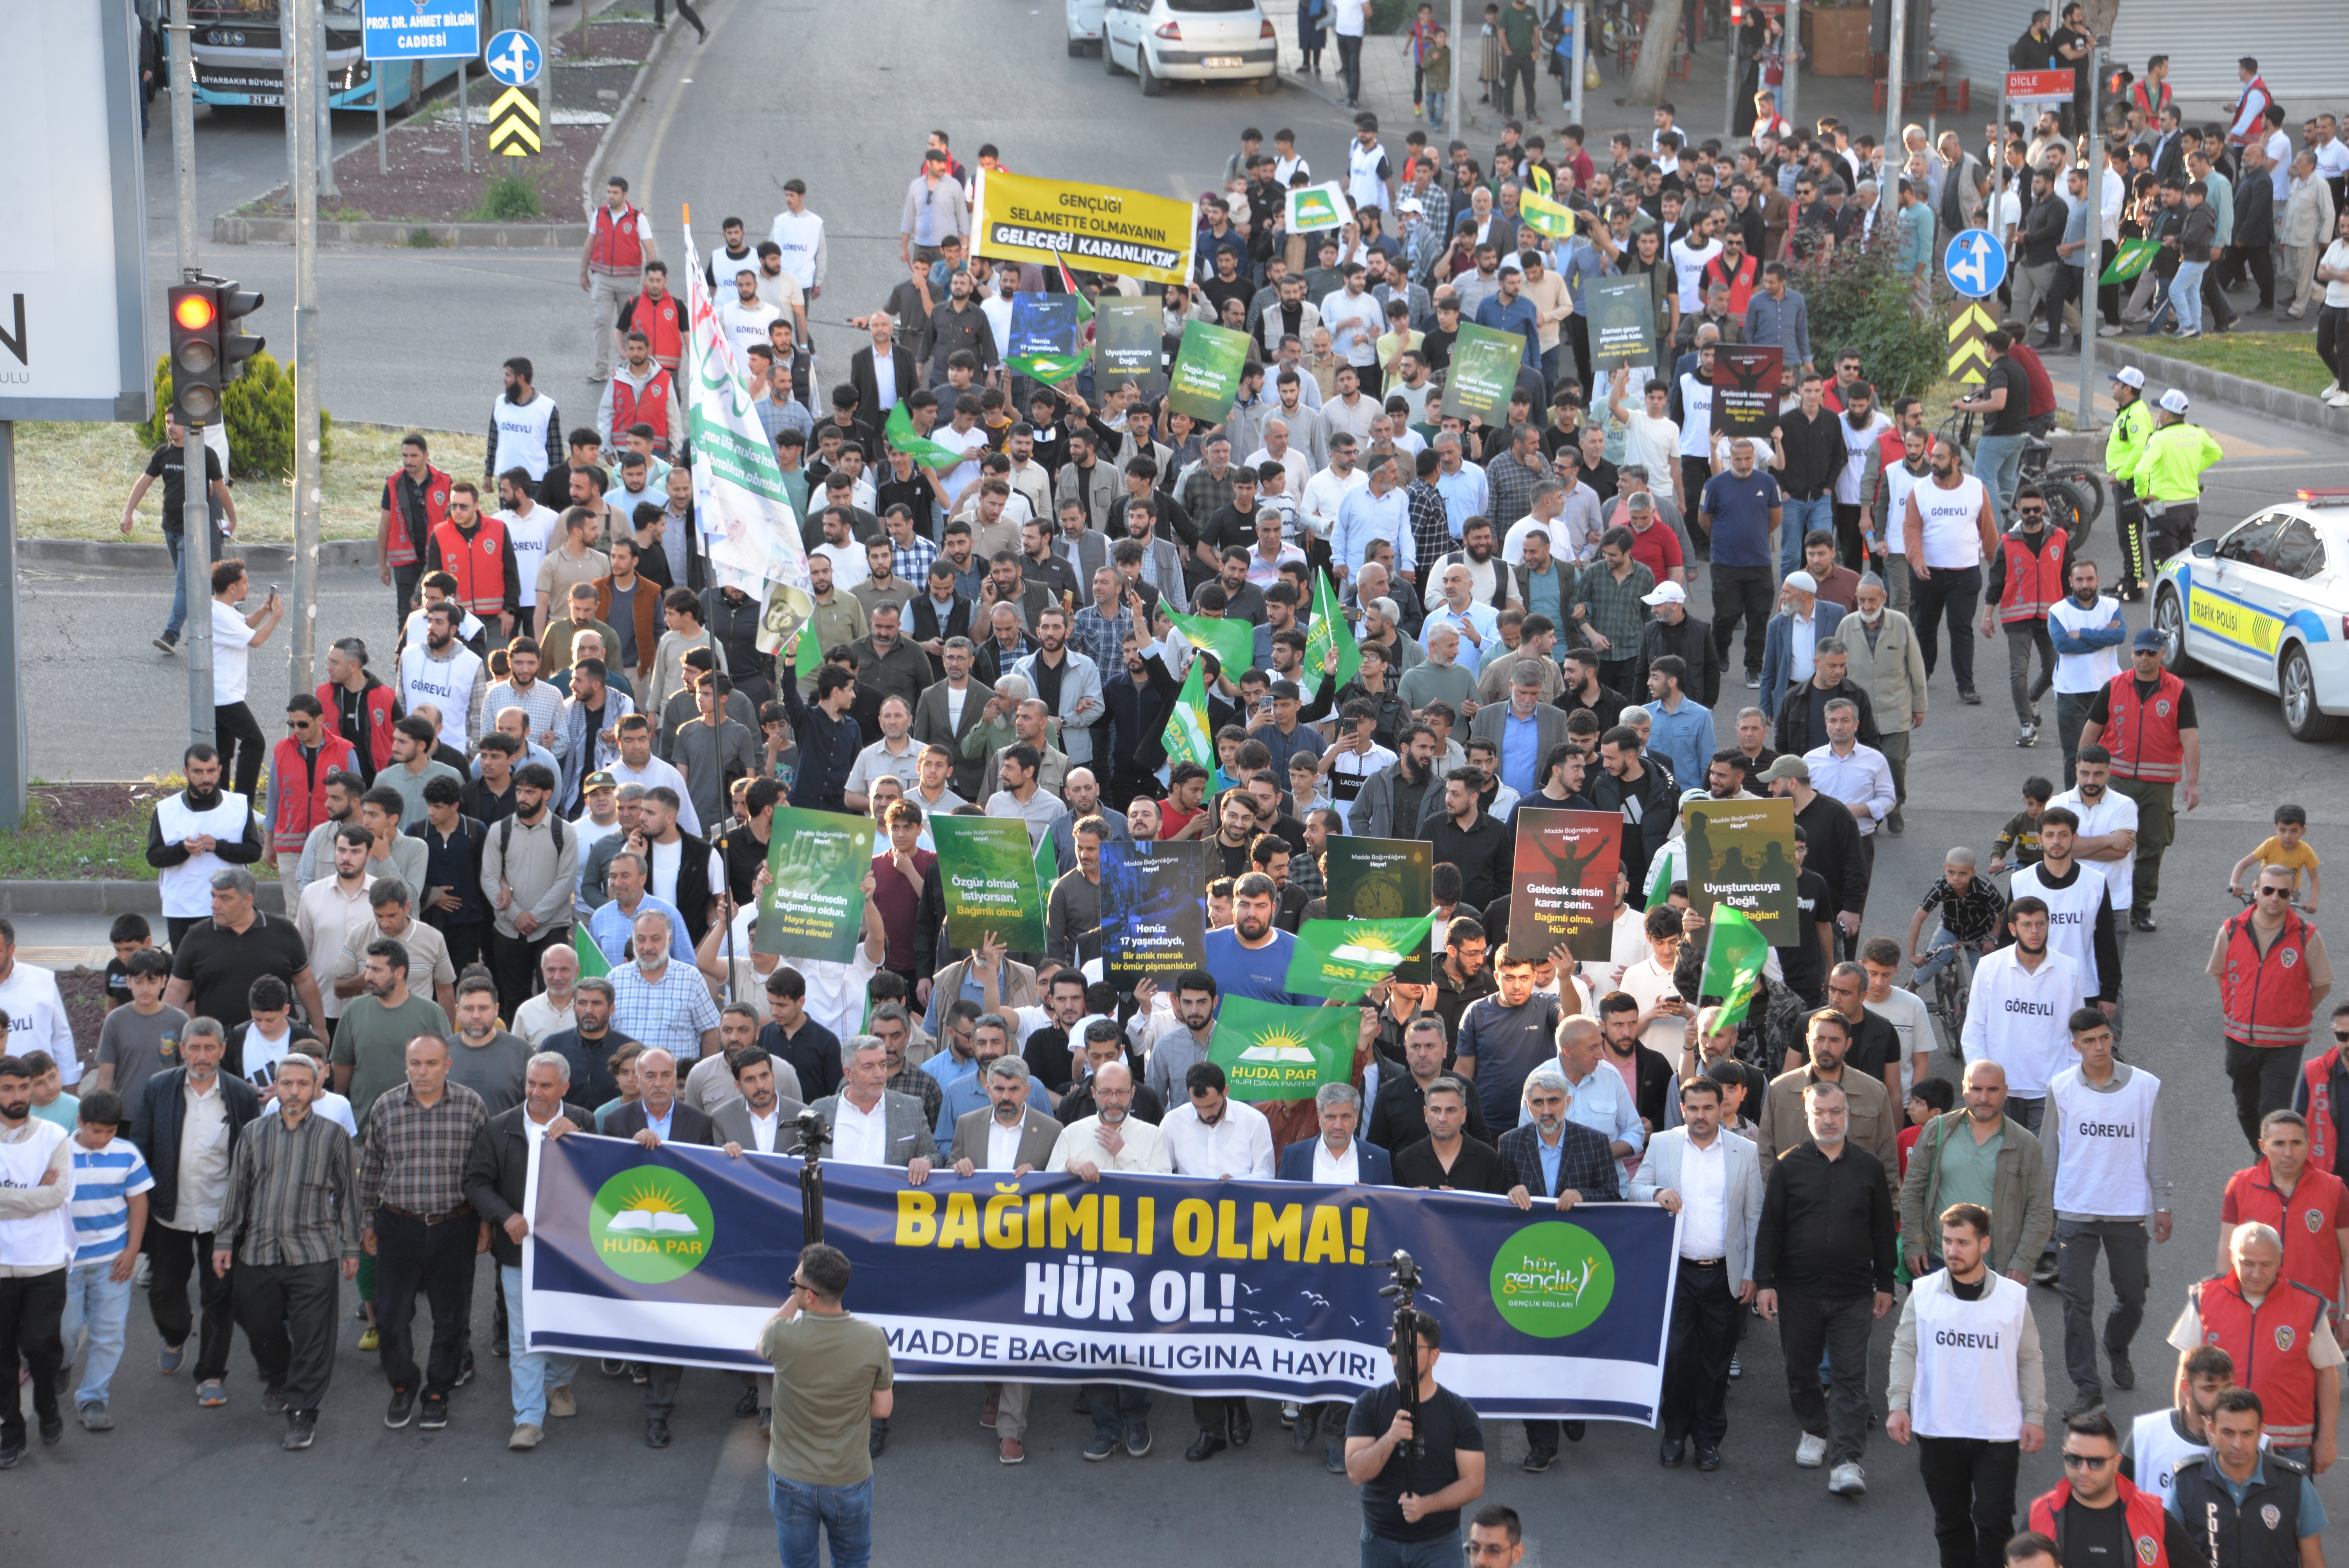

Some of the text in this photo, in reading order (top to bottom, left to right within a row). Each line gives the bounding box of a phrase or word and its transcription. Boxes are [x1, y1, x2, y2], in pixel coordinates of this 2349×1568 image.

[367, 13, 474, 29] PROF. DR. AHMET BİLGİN
[397, 32, 446, 48] CADDESİ
[201, 76, 284, 88] DİYARBAKIR BÜYÜKŞE
[2010, 75, 2038, 87] DİCLE
[1059, 193, 1122, 214] GENÇLİĞİ
[1010, 207, 1166, 243] SELAMETTE OLMAYANIN
[783, 243, 807, 252] GÖREVLİ
[996, 226, 1175, 270] GELECEĞİ KARANLIKTIR
[737, 326, 765, 336] GÖREVLİ
[1623, 326, 1640, 334] geçer
[1599, 335, 1628, 344] pişmanlık
[1119, 358, 1139, 366] Değil,
[1182, 362, 1227, 381] Özgür olmak
[1184, 374, 1221, 390] istiyorsan,
[1178, 383, 1222, 400] Bağımlı olma!
[1460, 392, 1474, 401] Hayır
[1720, 390, 1748, 398] Gelecek
[1693, 401, 1712, 410] GÖRE
[502, 422, 531, 434] GÖREVLİ
[1931, 506, 1967, 516] GÖREVLİ
[513, 541, 542, 551] ÖREVLİ
[2013, 558, 2024, 604] POLİS
[2193, 601, 2238, 632] TRAFİK POLİSİ
[411, 679, 451, 698] GÖREVLİ
[2114, 705, 2124, 757] POLİS
[283, 775, 293, 832] POLİS
[1730, 813, 1767, 823] Bağımlılığına
[1563, 827, 1599, 835] Bağımlılığına
[1142, 857, 1178, 866] Bağımlılığına
[952, 874, 1019, 889] Özgür olmak
[1704, 882, 1780, 894] Uyuşturucuya
[777, 888, 847, 905] Bir kez denedin
[961, 890, 1017, 905] istiyorsan,
[1526, 884, 1603, 897] Gelecek sensin
[1534, 898, 1593, 910] karar senin.
[1727, 896, 1759, 907] Değil,
[775, 900, 846, 918] bağımlısı oldun.
[956, 905, 1023, 918] Bağımlı olma!
[1742, 911, 1779, 921] Bağlan!
[784, 914, 834, 928] Hayır demek
[1534, 912, 1593, 925] Bağımlı olma,
[2050, 910, 2083, 925] REVLİ
[782, 925, 832, 939] senin elinde!
[1136, 923, 1166, 934] Henüz
[1549, 924, 1578, 934] Hür ol!
[1119, 936, 1185, 949] 17 yaşındaydı,
[1123, 951, 1183, 960] Bir anlık merak
[1111, 962, 1197, 973] bir ömür pişmanlıktır!
[2005, 999, 2054, 1016] GÖREVLİ
[1232, 1066, 1317, 1080] HÜDA PAR
[2313, 1083, 2328, 1157] POLİS
[2080, 1122, 2135, 1138] GÖREVLİ
[895, 1182, 1369, 1265] BAĞIMLI OLMA!
[603, 1237, 702, 1255] HÜDA PAR
[1524, 1255, 1556, 1272] hür
[1024, 1254, 1235, 1323] HÜR OL!
[1502, 1269, 1578, 1294] gençlik
[1508, 1299, 1573, 1308] GENÇLİK KOLLARI
[1935, 1329, 1999, 1349] GÖREVLİ
[882, 1326, 1375, 1381] MADDE BAGIMLILIGINA HAYIR!
